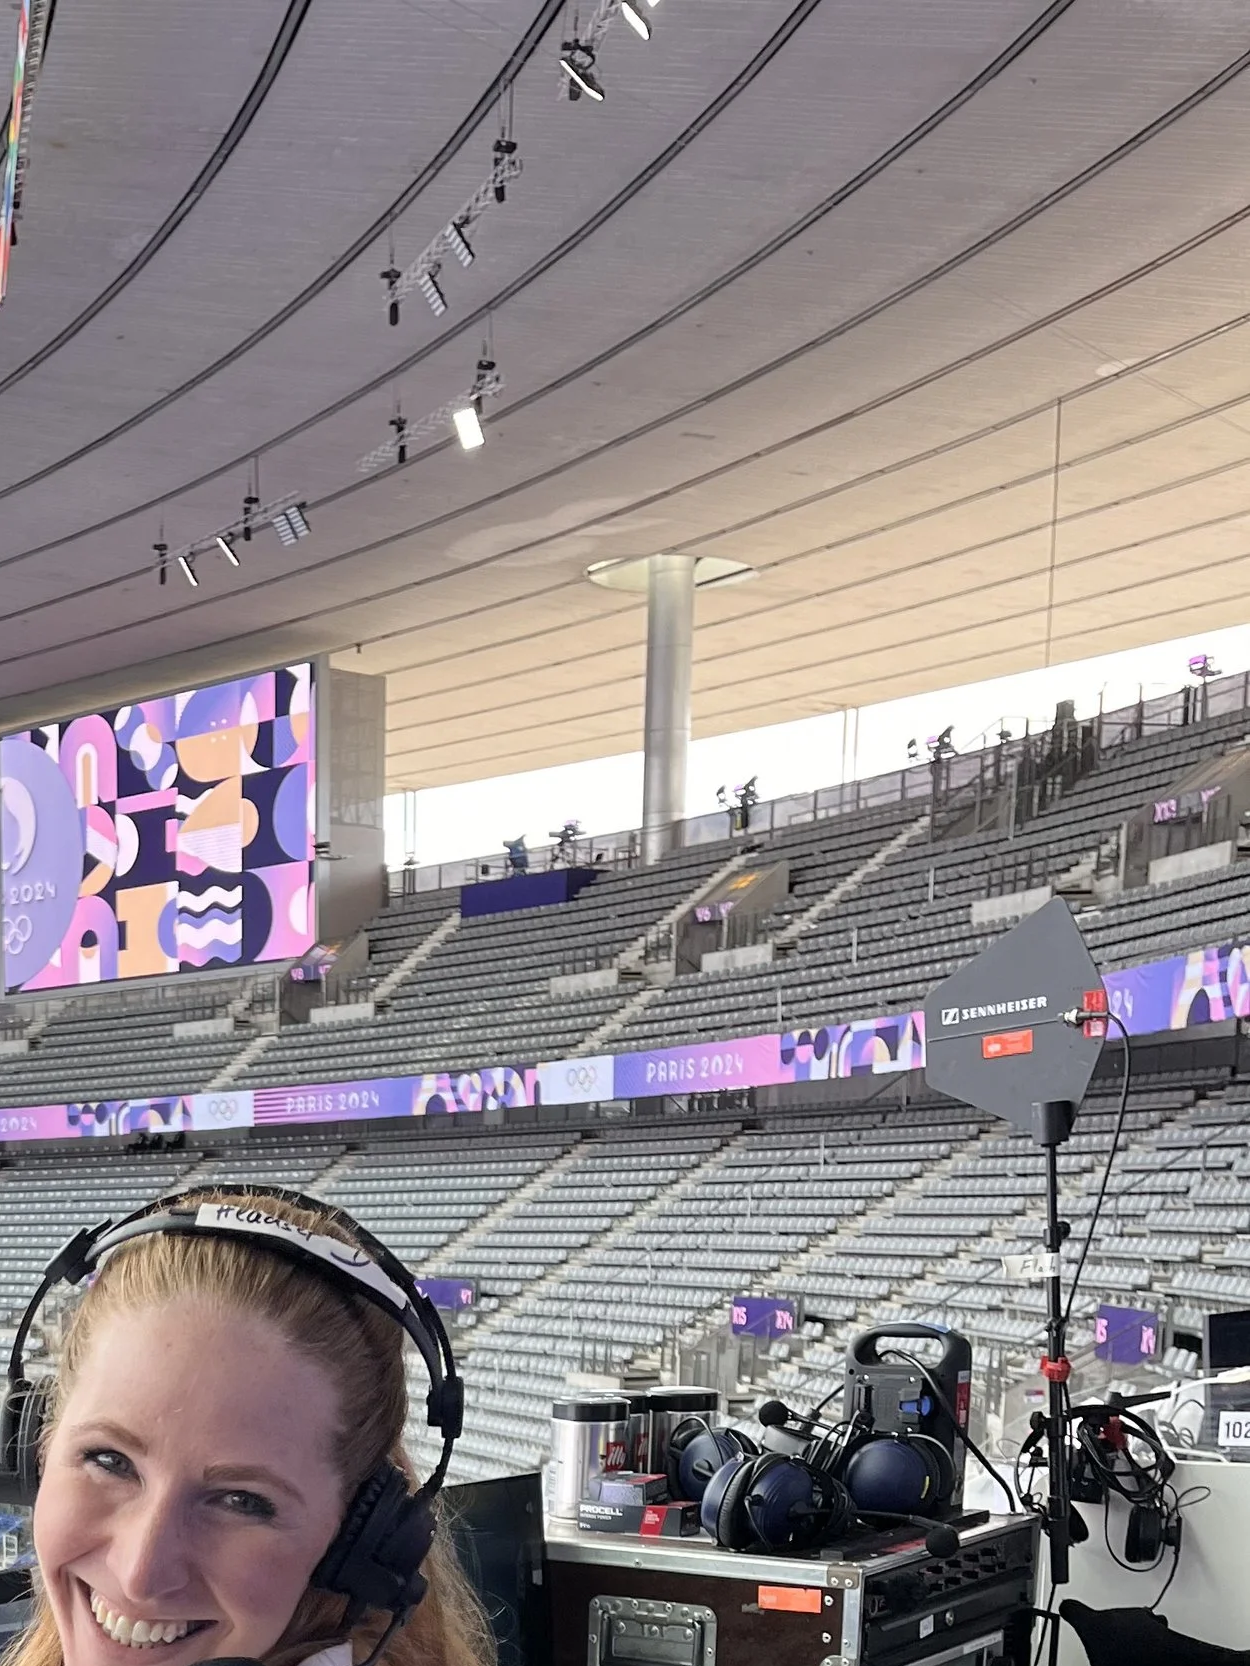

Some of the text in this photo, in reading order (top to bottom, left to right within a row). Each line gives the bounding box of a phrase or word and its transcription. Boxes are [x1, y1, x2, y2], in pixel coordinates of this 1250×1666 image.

[10, 882, 55, 905] 2024
[962, 997, 1047, 1020] SENNHEISER
[645, 1053, 744, 1082] PARIS 2024
[286, 1090, 379, 1113] PARIS 2024
[0, 1115, 37, 1132] 2024
[607, 1445, 626, 1468] illy
[579, 1504, 621, 1516] PROCELL
